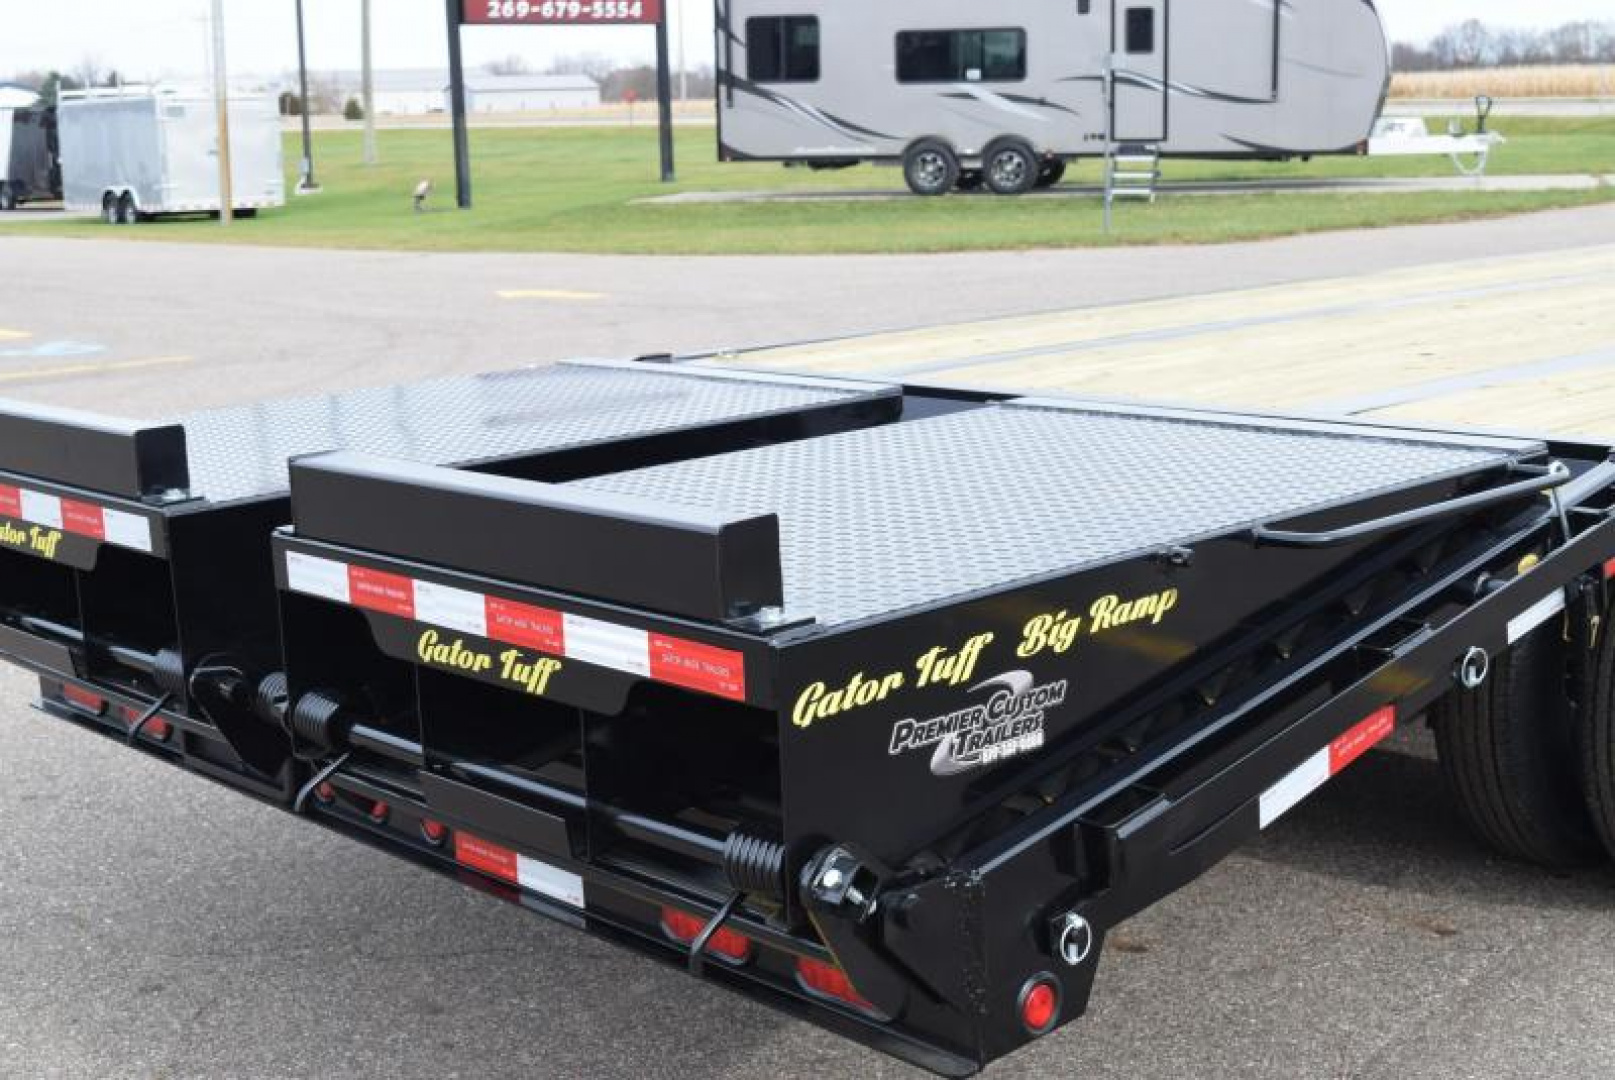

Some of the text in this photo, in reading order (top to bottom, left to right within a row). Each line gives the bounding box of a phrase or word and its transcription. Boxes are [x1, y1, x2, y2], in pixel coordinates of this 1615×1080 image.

[486, 1, 643, 18] 269-679-5554
[30, 525, 62, 559] Tuff
[418, 629, 562, 695] Gator Tuff
[791, 587, 1178, 729] Gator Tuff Big Ramp
[888, 704, 986, 755] PREMIER
[987, 679, 1068, 723] CUSTOM
[953, 710, 1045, 763] TRAILERS
